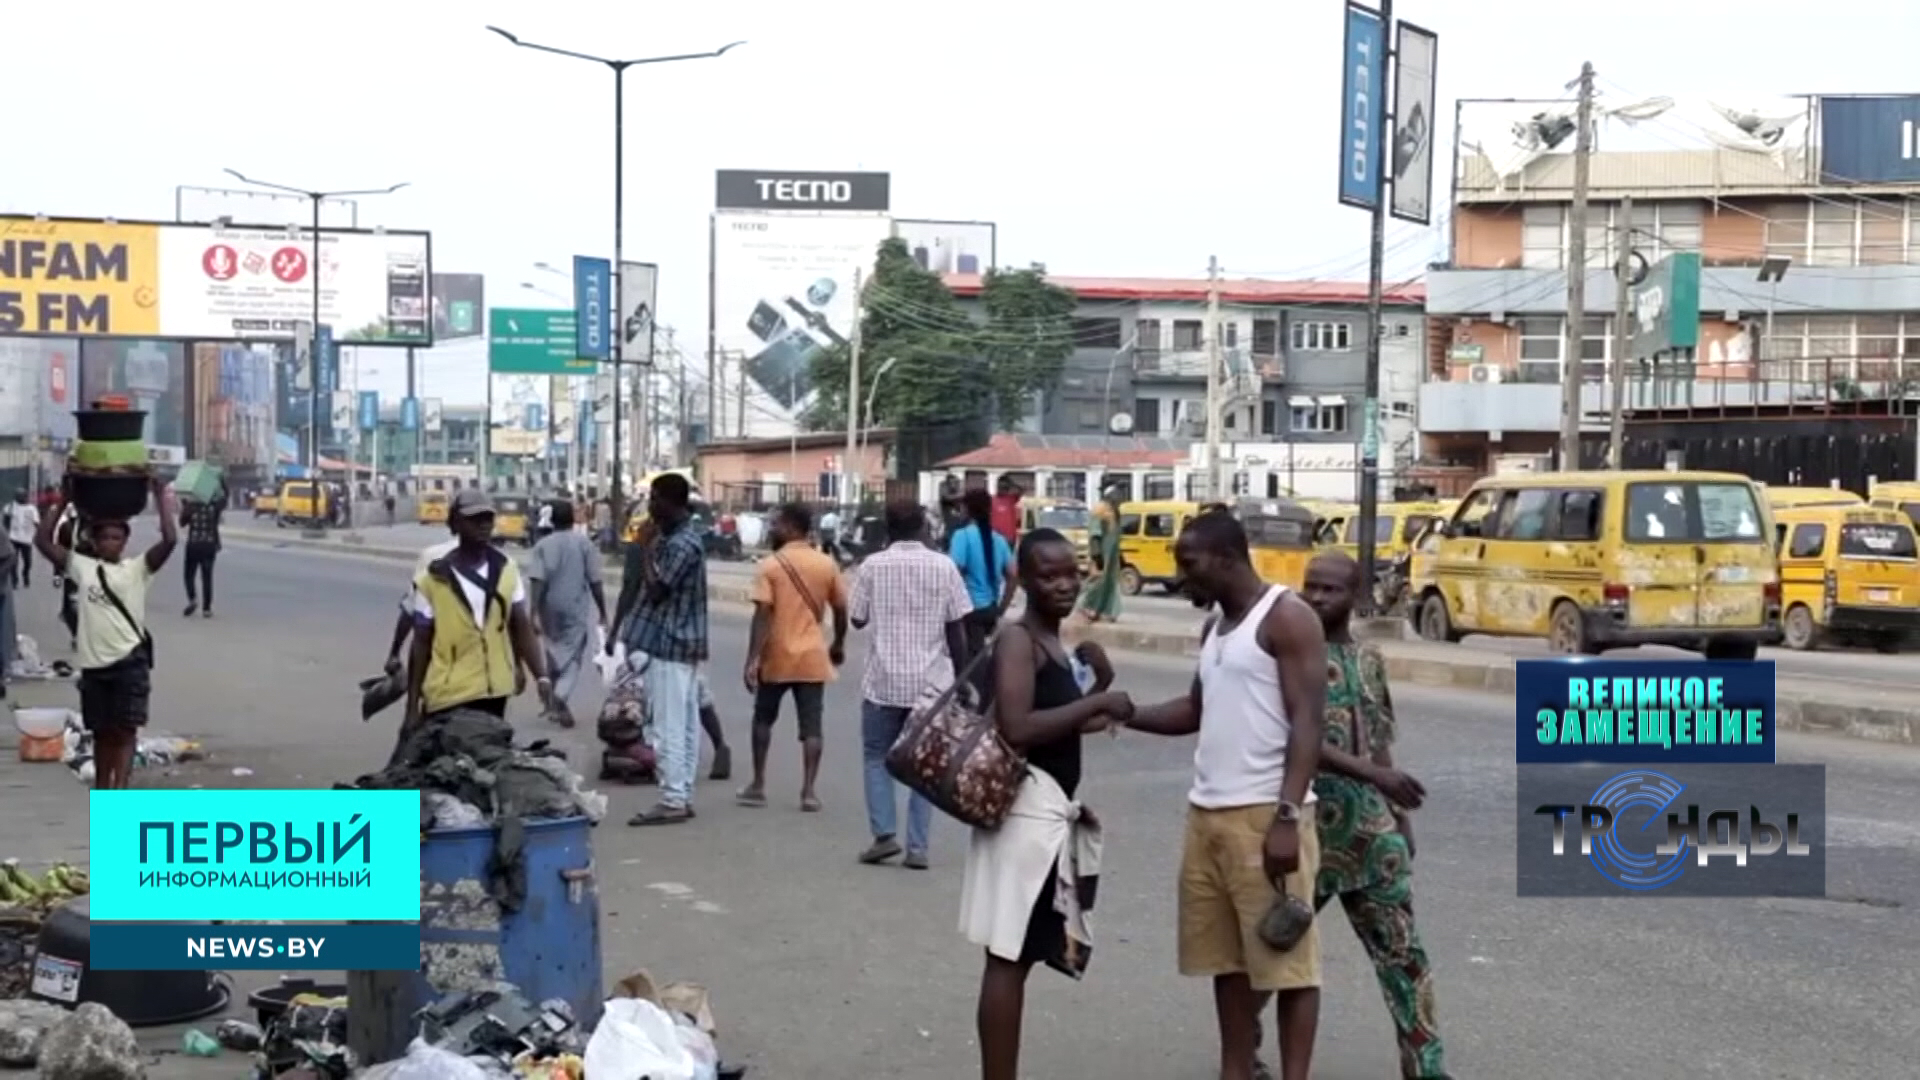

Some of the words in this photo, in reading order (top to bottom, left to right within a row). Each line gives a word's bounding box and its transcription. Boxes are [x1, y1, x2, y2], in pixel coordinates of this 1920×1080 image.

[1354, 37, 1371, 182] TECNO
[1902, 120, 1920, 159] I
[755, 179, 851, 202] TECNO
[37, 293, 108, 332] FM
[586, 271, 601, 349] TECNO
